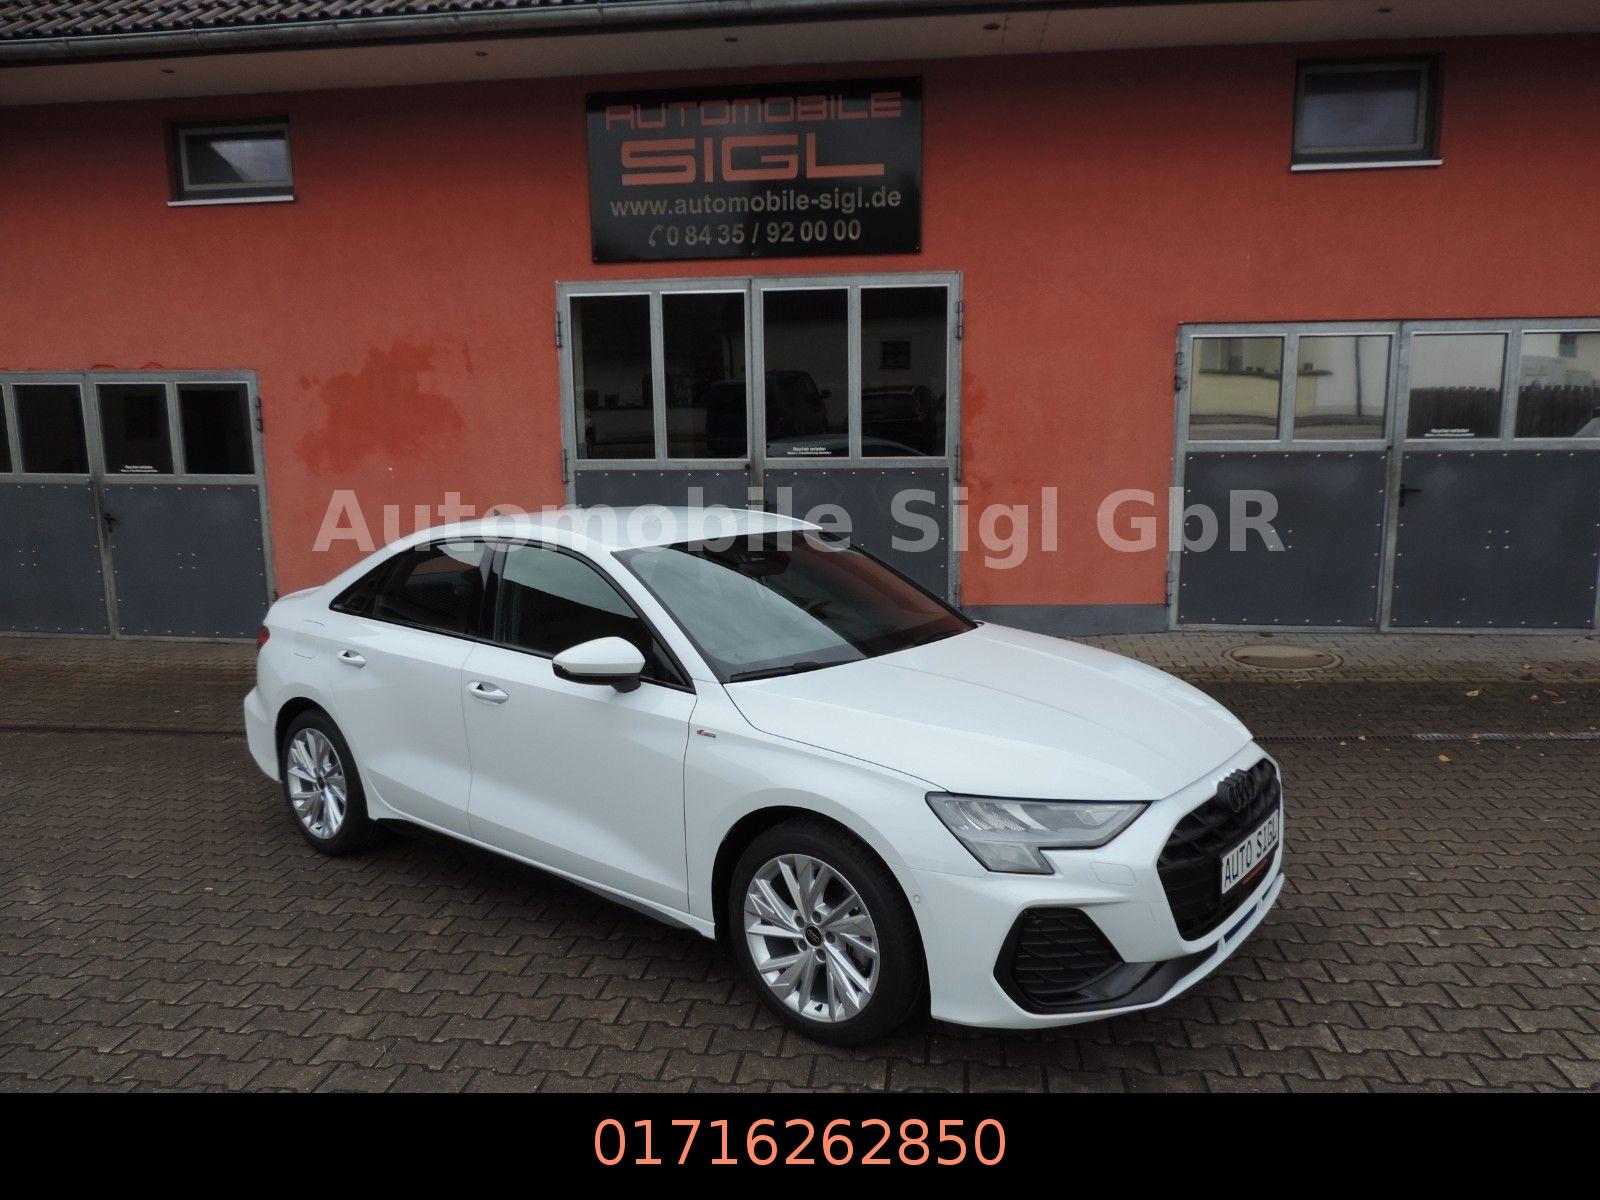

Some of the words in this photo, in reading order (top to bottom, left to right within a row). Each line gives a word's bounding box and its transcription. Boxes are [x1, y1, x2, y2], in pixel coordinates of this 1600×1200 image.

[605, 91, 901, 130] AUTOMOBILE
[621, 132, 884, 186] SIGL
[610, 186, 901, 216] www.automobile-sigl.de
[667, 226, 679, 246] 0
[685, 225, 712, 246] 84
[718, 224, 745, 245] 35
[766, 222, 795, 243] 92
[800, 221, 828, 242] 00
[833, 220, 861, 241] 00
[1224, 840, 1253, 887] AUTO
[1256, 817, 1277, 857] SIGL
